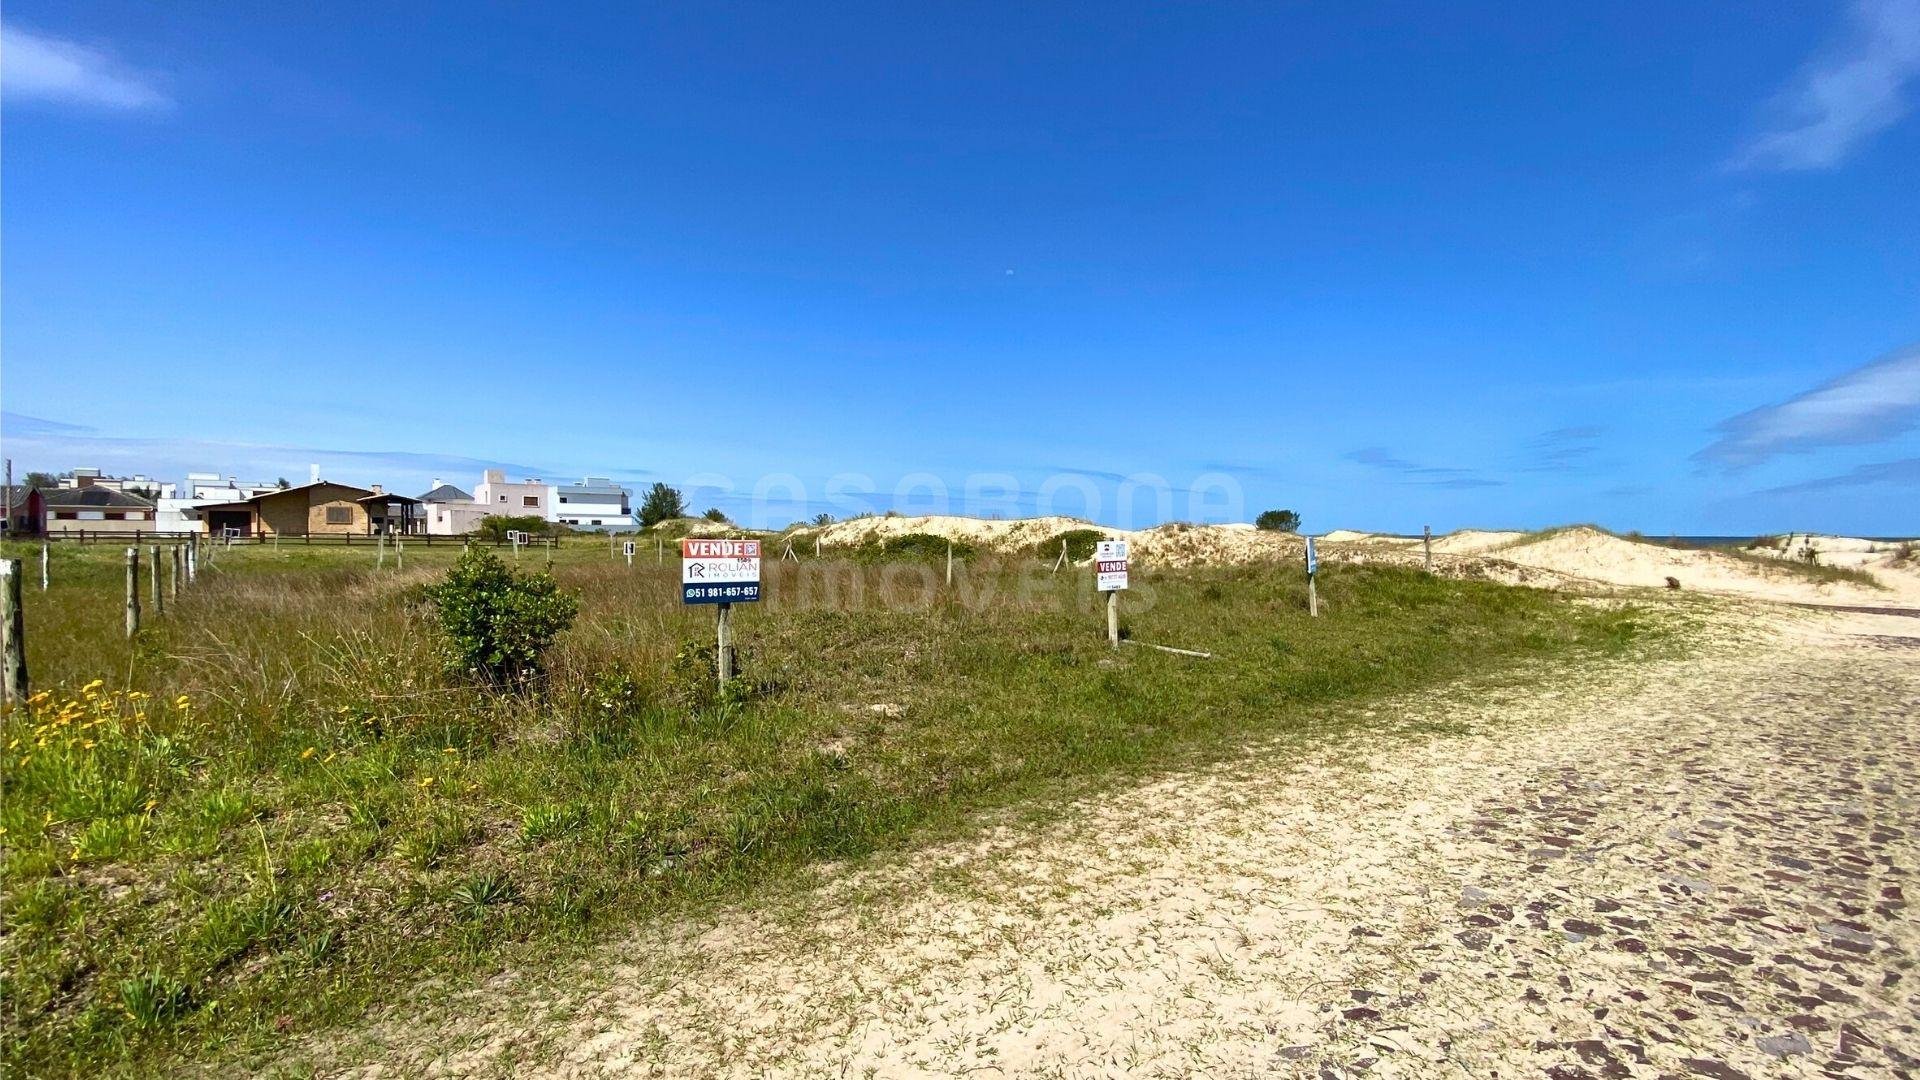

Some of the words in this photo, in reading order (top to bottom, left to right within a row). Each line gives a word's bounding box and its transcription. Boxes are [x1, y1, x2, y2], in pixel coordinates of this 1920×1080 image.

[687, 542, 744, 556] VENDE
[708, 563, 757, 571] ROLIAN
[1100, 562, 1127, 571] VENDE
[695, 588, 705, 597] 51
[707, 586, 759, 597] 981-657-657
